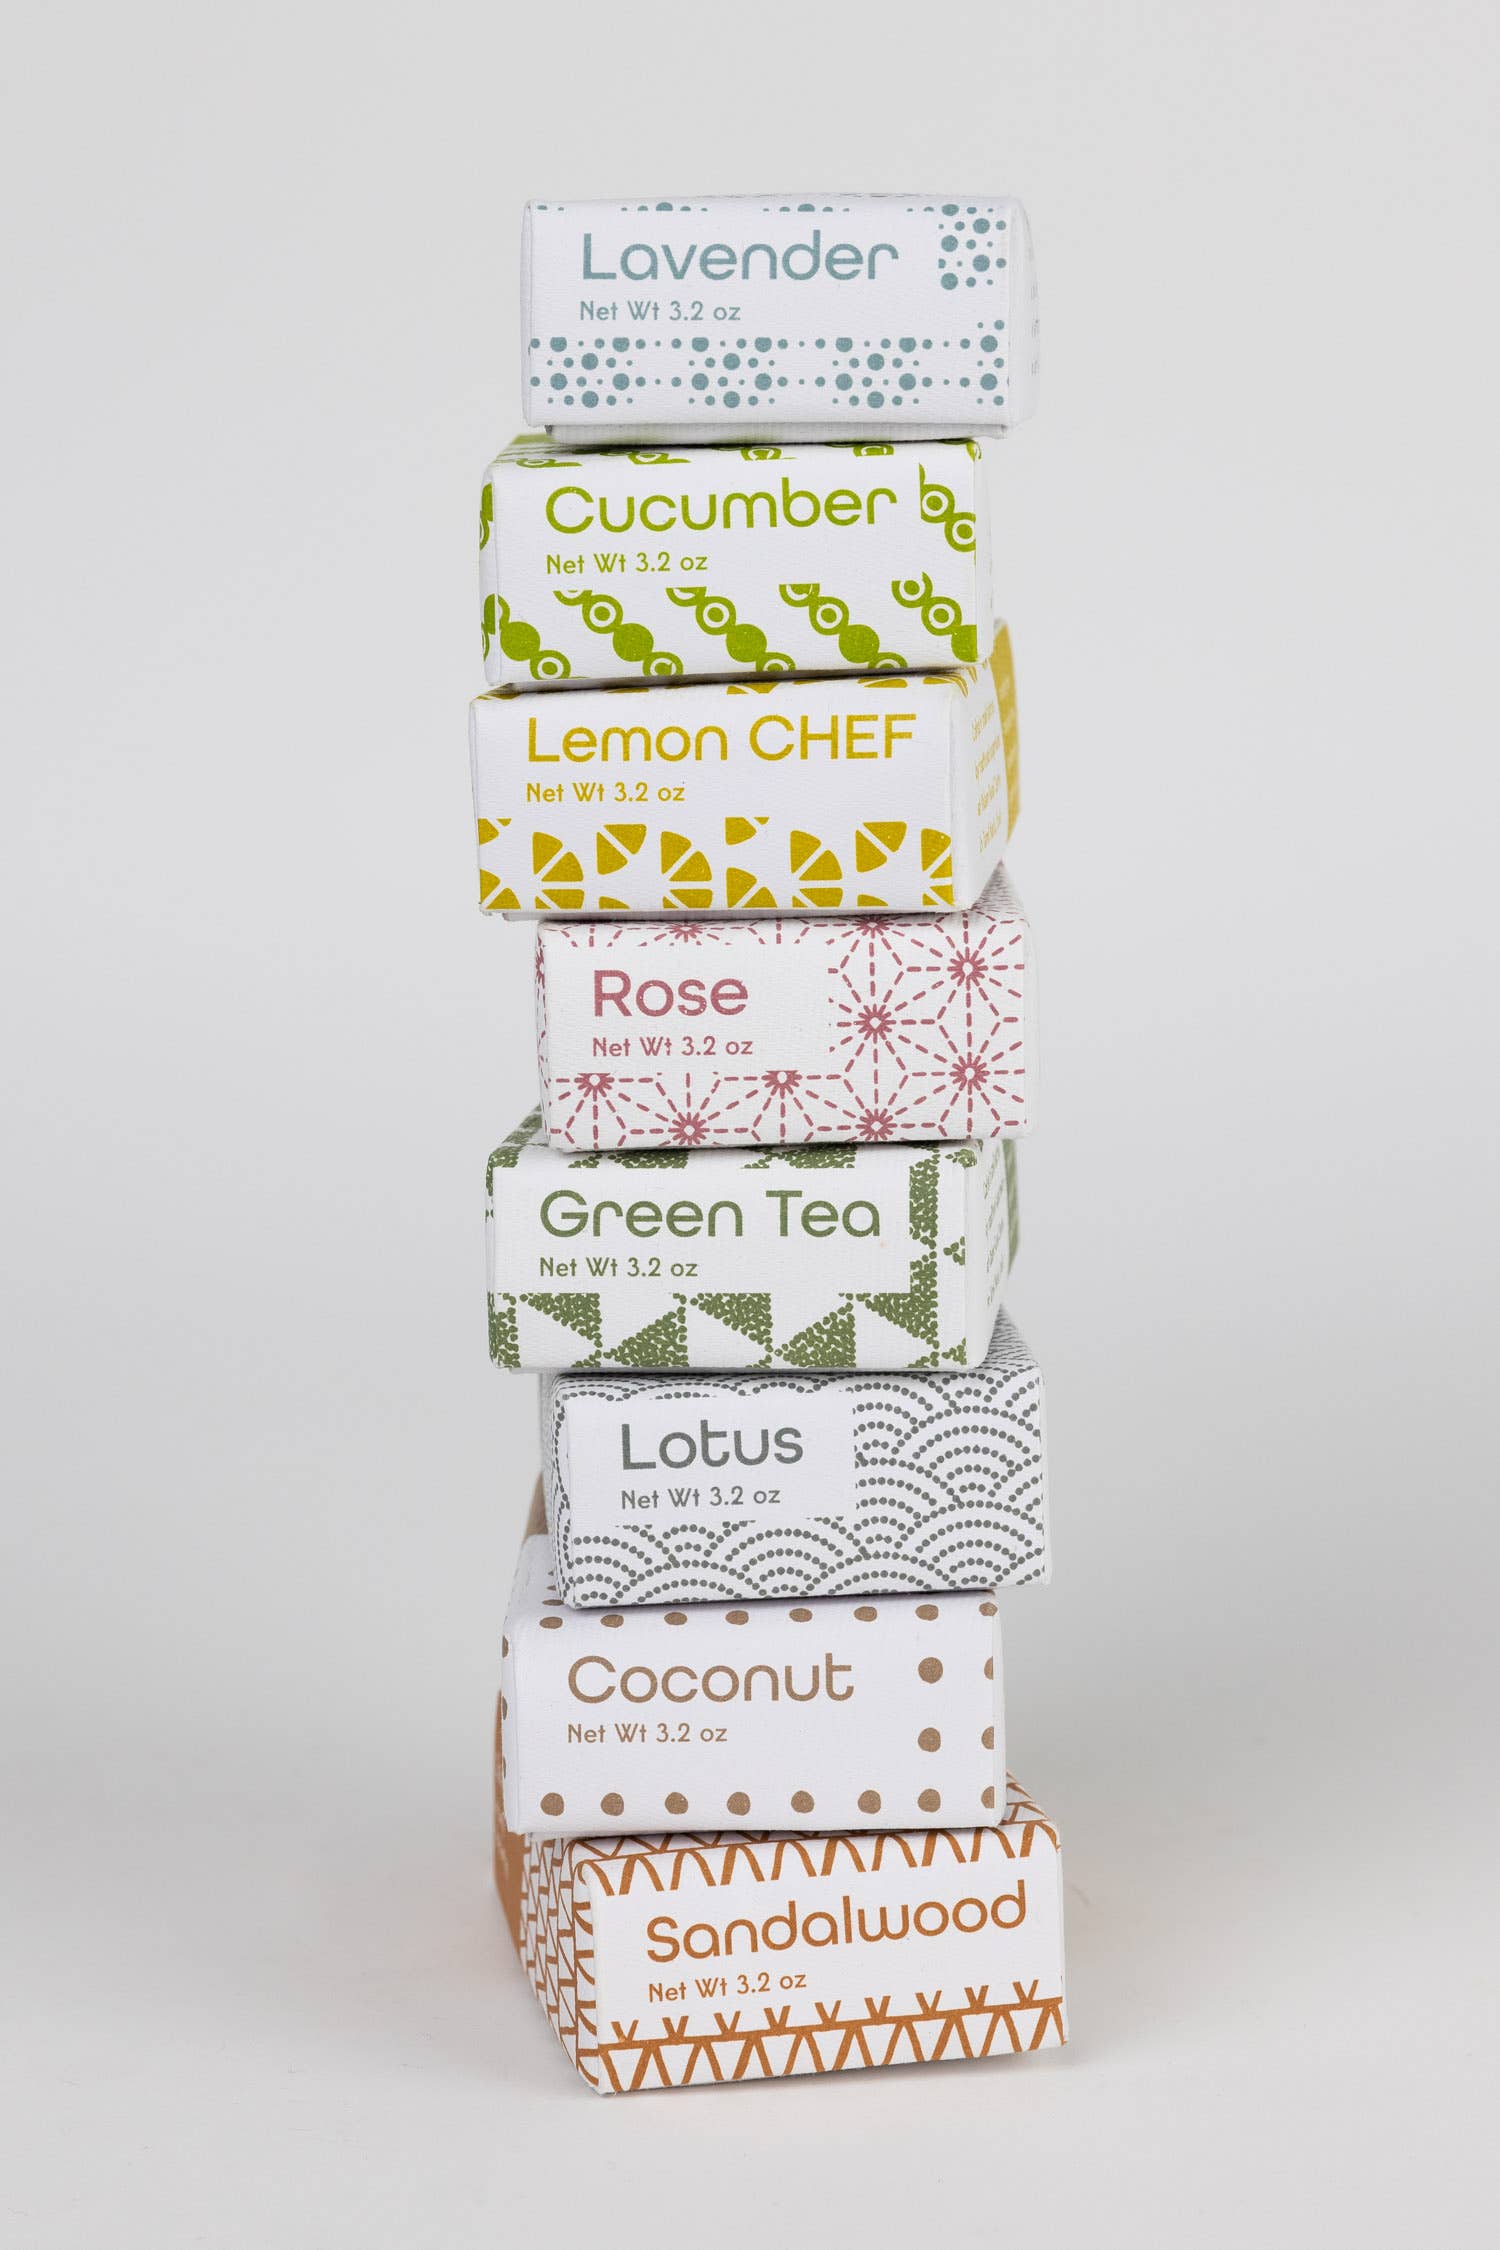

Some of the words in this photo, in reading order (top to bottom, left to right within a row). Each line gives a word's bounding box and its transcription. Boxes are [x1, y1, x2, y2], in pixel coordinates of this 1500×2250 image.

[582, 229, 899, 281] Lavender
[580, 300, 618, 321] Net
[627, 300, 660, 321] Wt
[669, 300, 704, 321] 3.2
[713, 306, 741, 321] oz
[544, 475, 898, 535] Cucumber
[545, 553, 585, 576] Net
[592, 552, 627, 574] Wt
[634, 550, 671, 573] 3.2
[679, 555, 709, 572] oz
[527, 716, 729, 764] Lemon
[748, 712, 918, 762] CHEF
[525, 782, 565, 804] Net
[571, 781, 606, 803] Wt
[613, 780, 649, 803] 3.2
[656, 786, 686, 803] oz
[593, 969, 749, 1018] Rose
[592, 1036, 631, 1057] Net
[639, 1036, 673, 1057] Wt
[681, 1035, 717, 1057] 3.2
[725, 1040, 753, 1056] oz
[539, 1189, 744, 1239] Green
[765, 1189, 881, 1238] Tea
[539, 1256, 578, 1278] Net
[585, 1256, 618, 1278] Wt
[626, 1256, 662, 1278] 3.2
[670, 1262, 699, 1278] oz
[621, 1419, 804, 1471] Lotus
[621, 1489, 660, 1510] Net
[667, 1487, 701, 1508] Wt
[709, 1485, 744, 1507] 3.2
[752, 1489, 781, 1505] oz
[567, 1652, 855, 1705] Coconut
[567, 1723, 606, 1744] Net
[614, 1722, 647, 1744] Wt
[655, 1722, 691, 1743] 3.2
[699, 1727, 728, 1743] oz
[646, 1878, 1027, 1964] Sandalwood
[648, 1981, 687, 2004] Net
[694, 1976, 728, 1999] Wt
[736, 1971, 771, 1995] 3.2
[778, 1973, 807, 1991] oz
